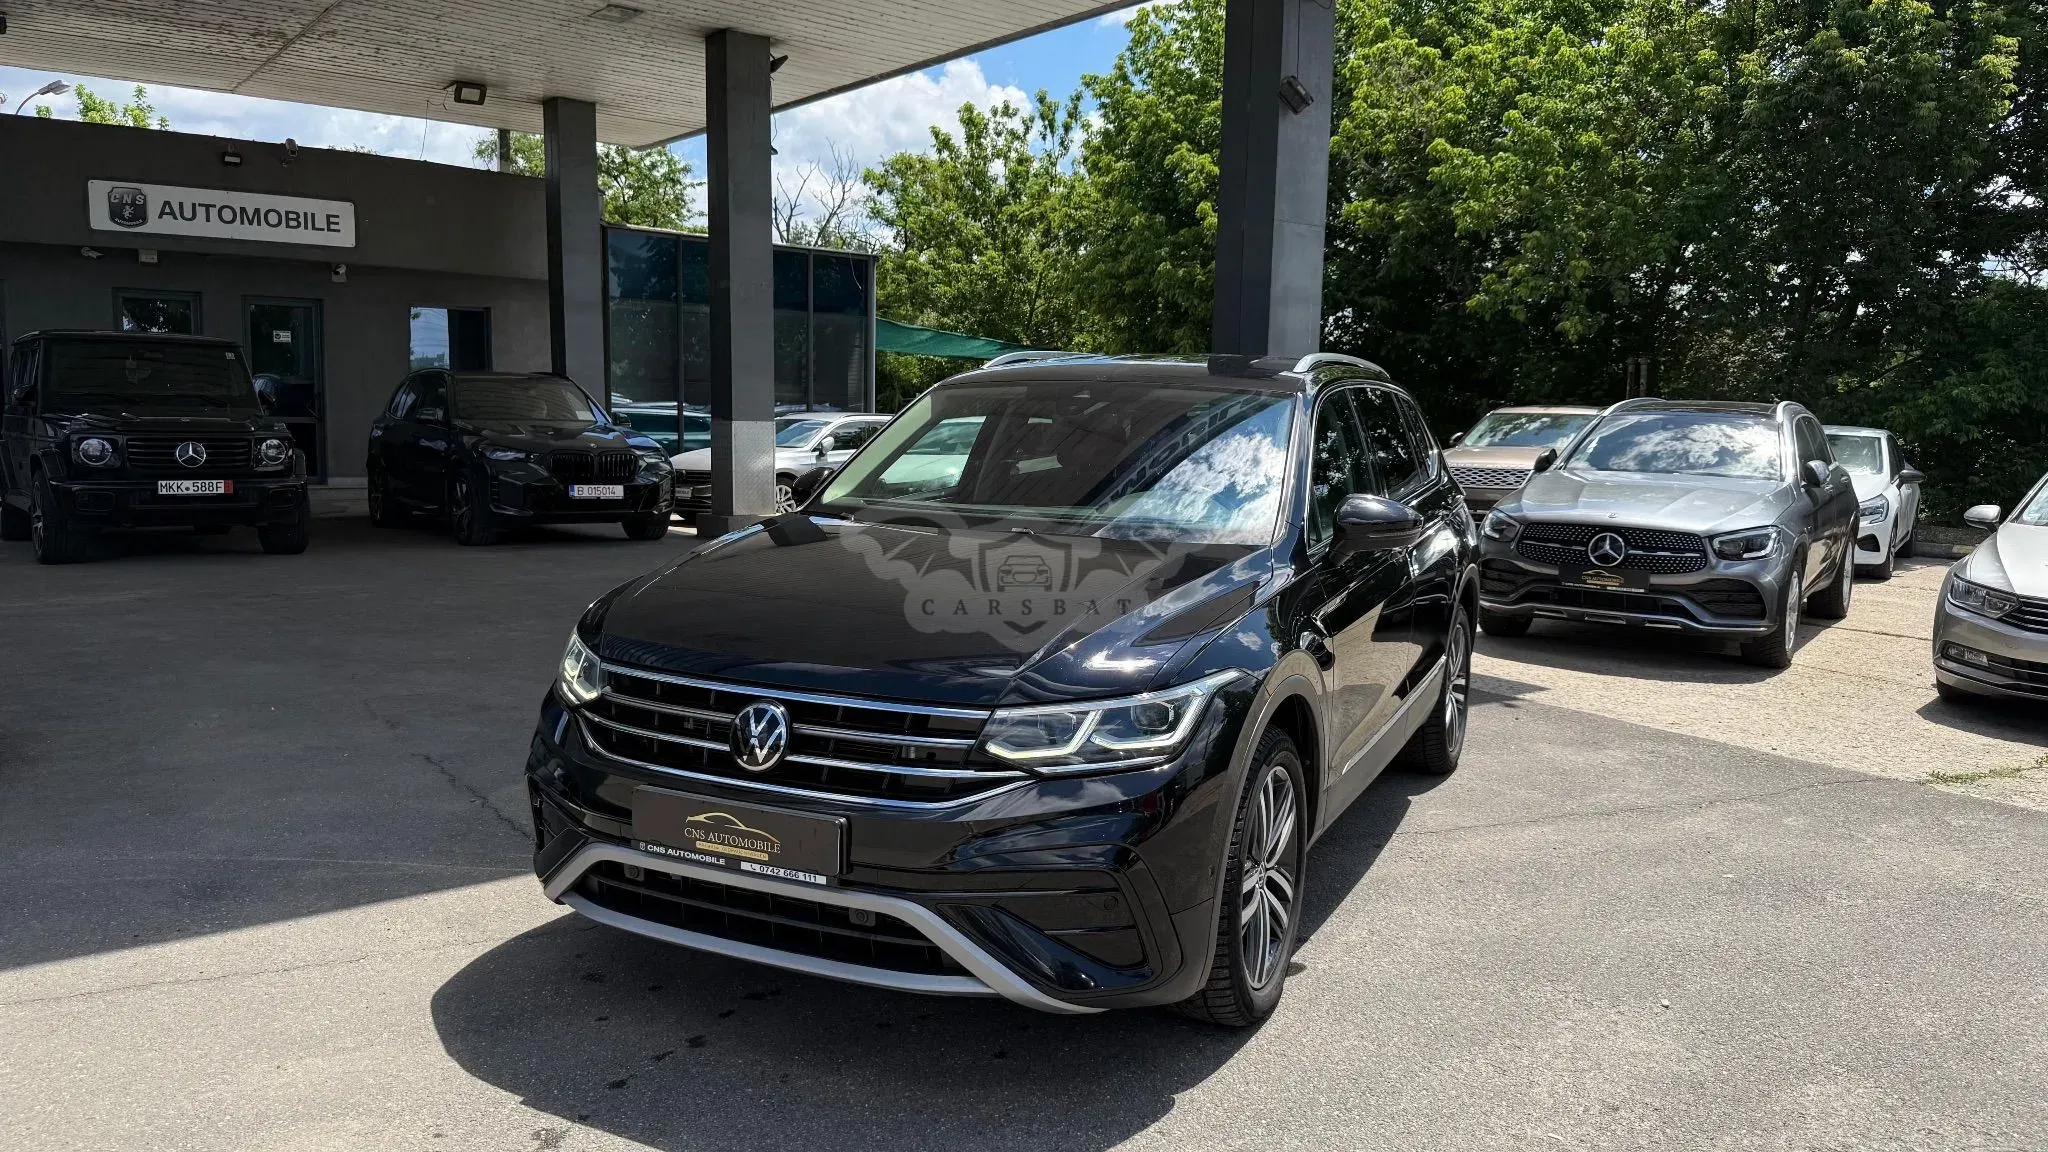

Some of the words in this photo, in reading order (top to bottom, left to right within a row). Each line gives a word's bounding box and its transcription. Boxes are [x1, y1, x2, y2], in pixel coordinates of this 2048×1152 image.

[110, 193, 145, 205] CNS
[157, 200, 341, 233] AUTOMOBILE
[160, 481, 184, 493] MKK
[192, 481, 223, 492] 588F
[577, 486, 584, 496] B
[587, 486, 616, 496] 015014
[684, 827, 706, 840] CNS
[707, 831, 781, 854] AUTOMOBILE
[647, 844, 666, 854] CNS
[667, 848, 726, 866] AUTOMOBILE
[759, 865, 781, 876] 0742
[783, 869, 800, 879] 666
[802, 873, 817, 883] 111
